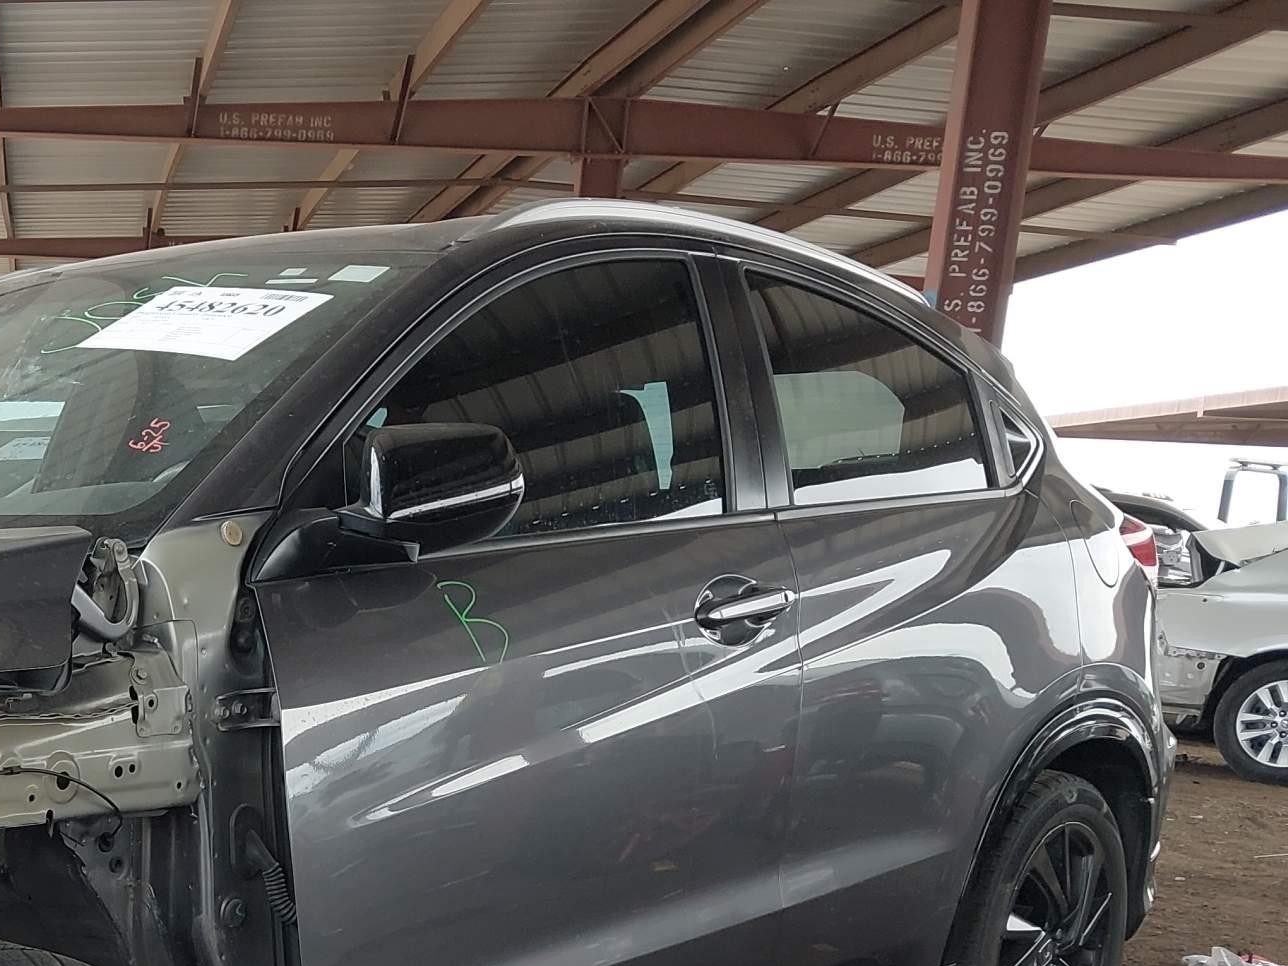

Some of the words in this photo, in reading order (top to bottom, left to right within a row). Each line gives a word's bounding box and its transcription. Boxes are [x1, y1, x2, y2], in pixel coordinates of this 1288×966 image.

[219, 111, 245, 126] U.S.
[251, 112, 304, 127] PREFAB
[872, 133, 899, 149] U.S.
[963, 127, 988, 172] INC.
[948, 186, 979, 277] PREFAB
[967, 130, 1009, 333] 1-866-799-0969
[155, 299, 286, 317] 45482620
